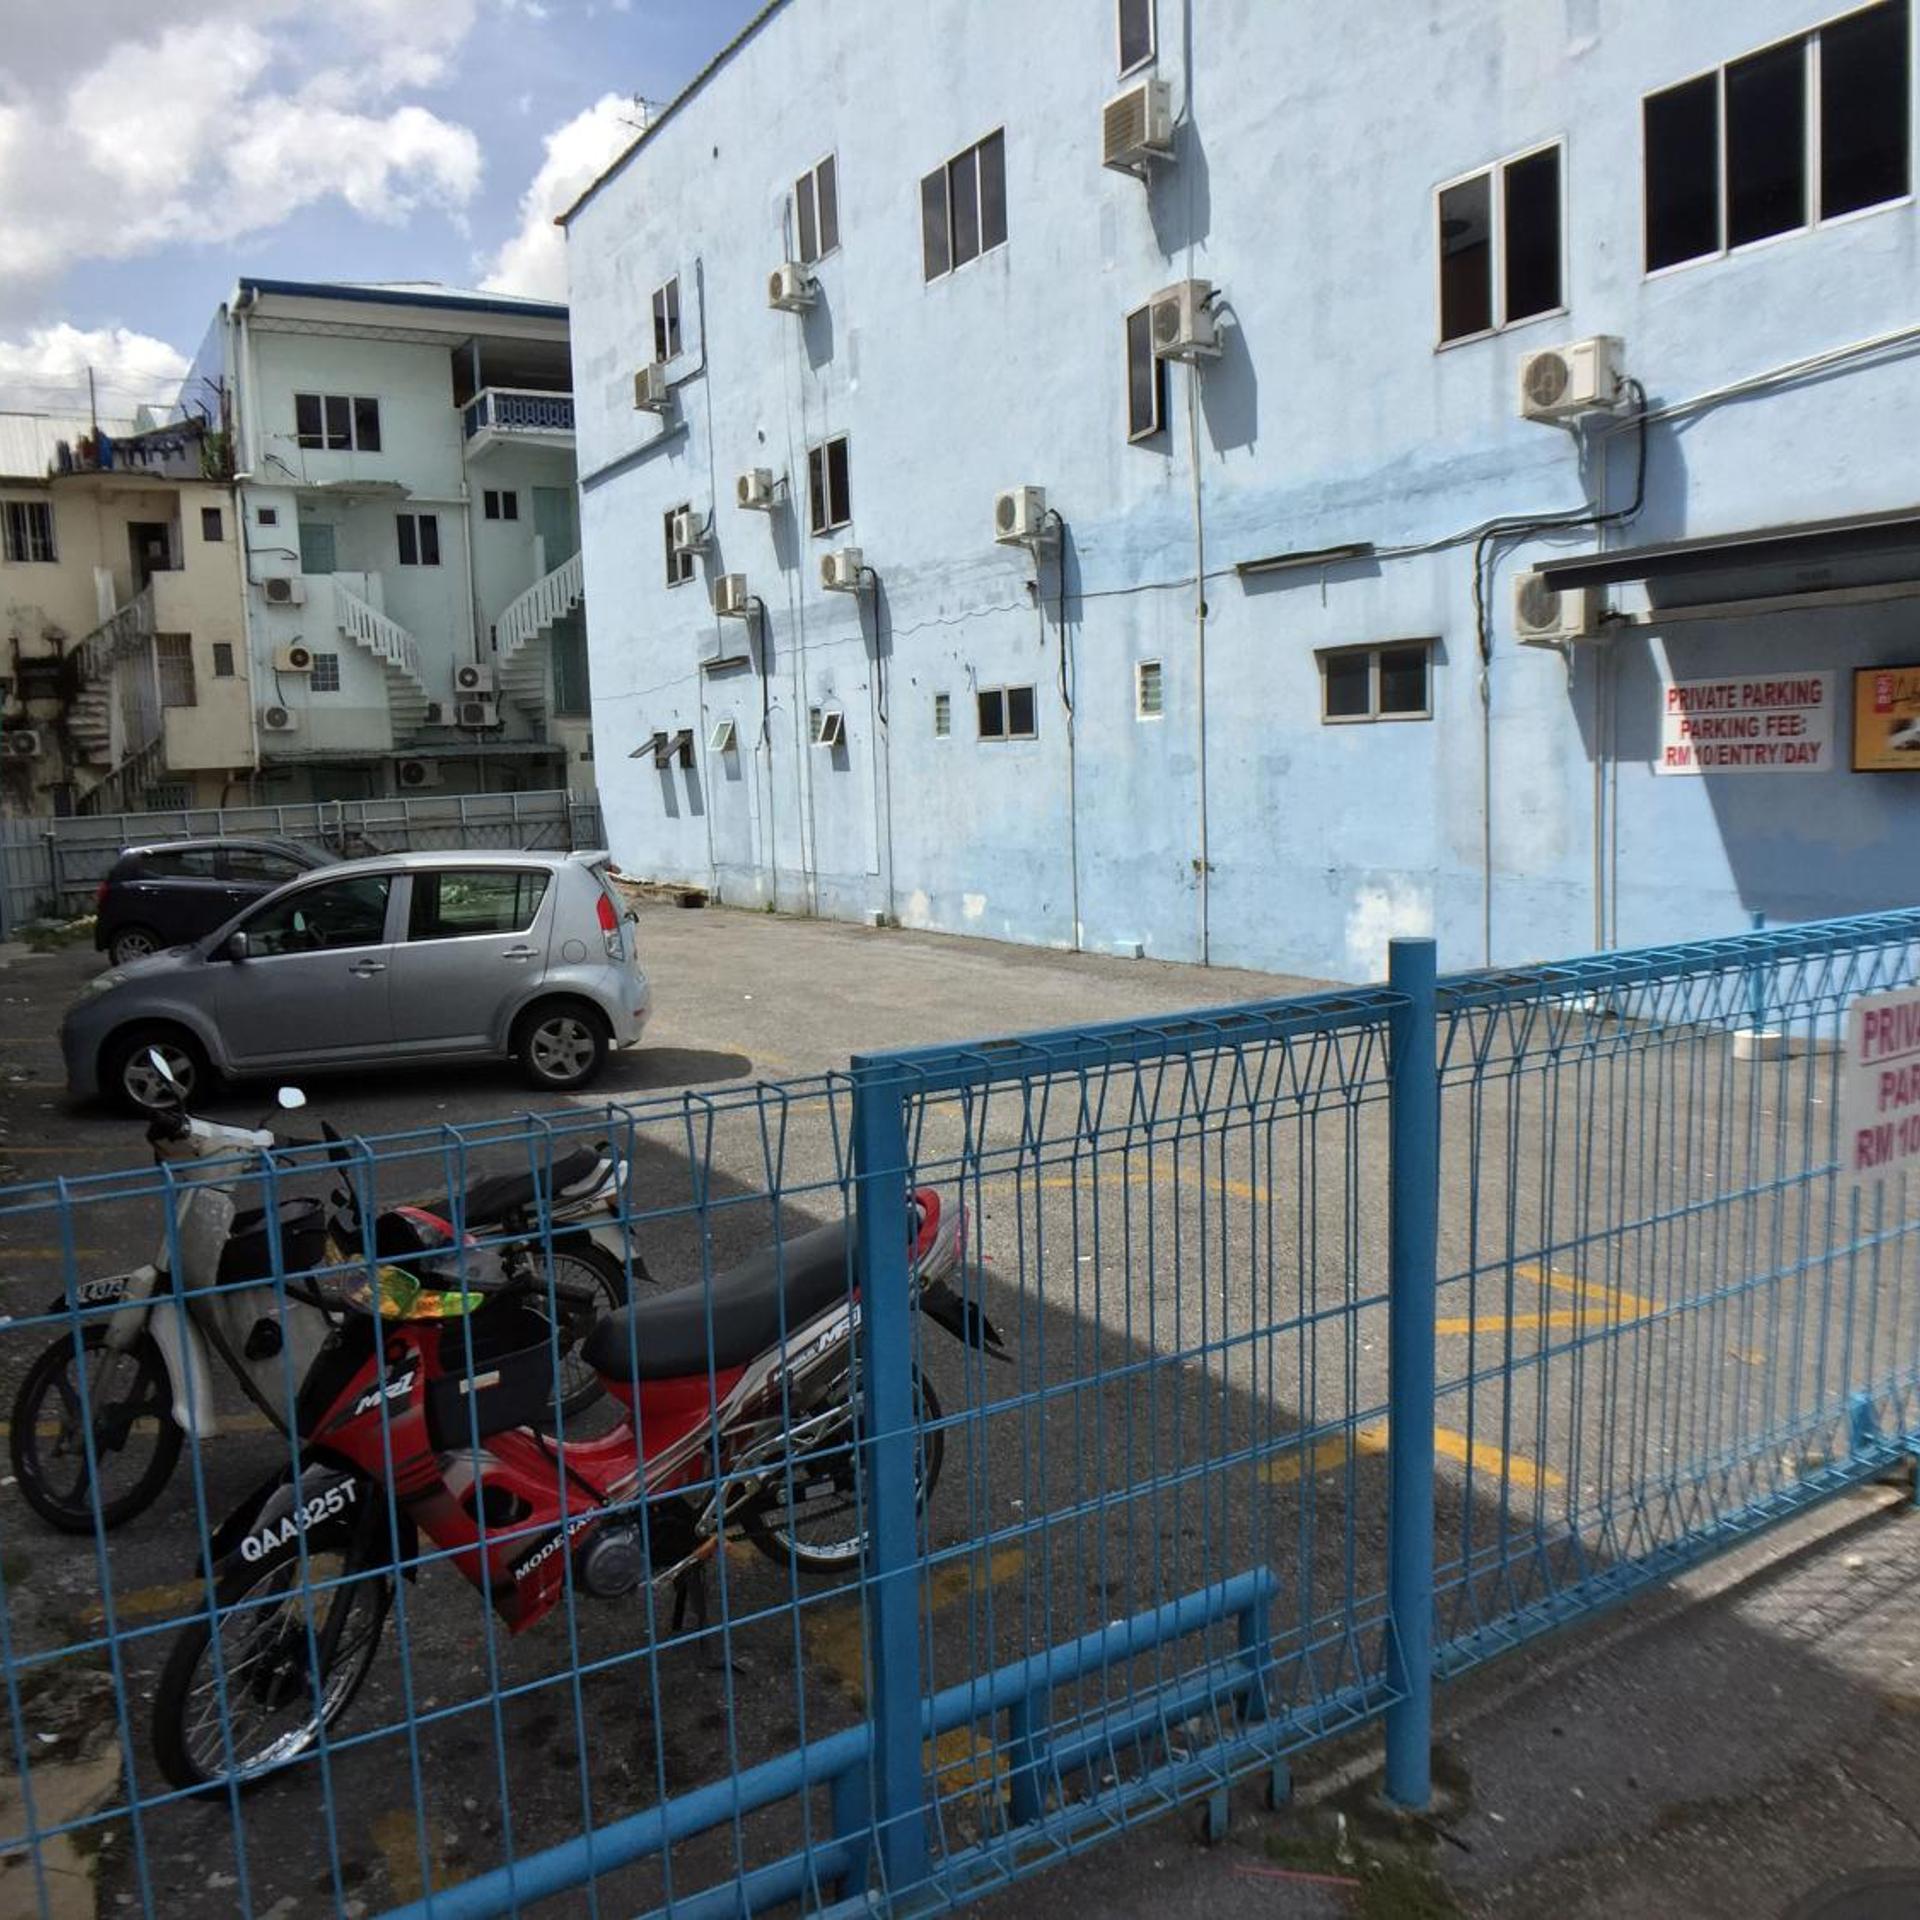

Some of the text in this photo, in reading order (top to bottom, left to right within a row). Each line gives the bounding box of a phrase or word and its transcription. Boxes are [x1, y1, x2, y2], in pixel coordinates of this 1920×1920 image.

[1668, 679, 1823, 711] PRIVATE PARKING
[1681, 716, 1760, 740] PARKING
[1666, 746, 1691, 766] RM
[1857, 1122, 1894, 1170] RM
